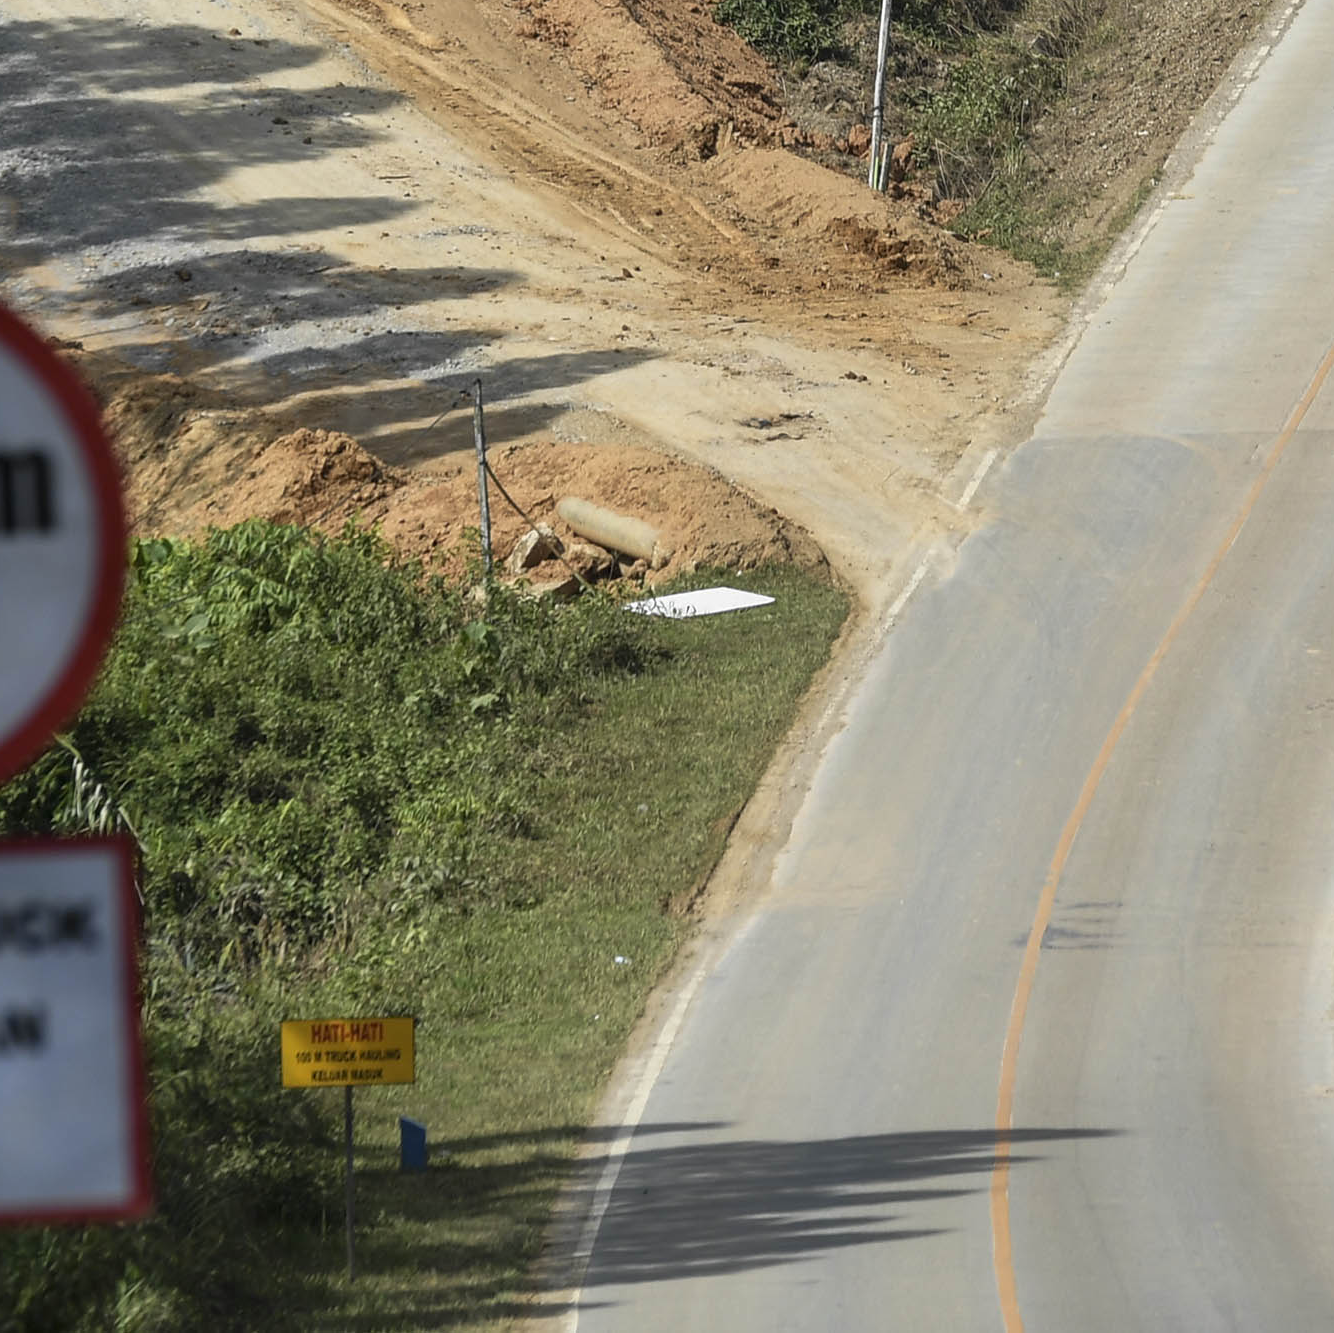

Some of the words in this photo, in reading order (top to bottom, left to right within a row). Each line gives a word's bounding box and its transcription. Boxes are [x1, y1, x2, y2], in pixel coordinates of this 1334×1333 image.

[311, 1023, 383, 1043] HATI-HATI
[325, 1049, 357, 1063] TRUCK
[311, 1069, 348, 1082] KELUAR
[350, 1068, 384, 1081] MASUK
